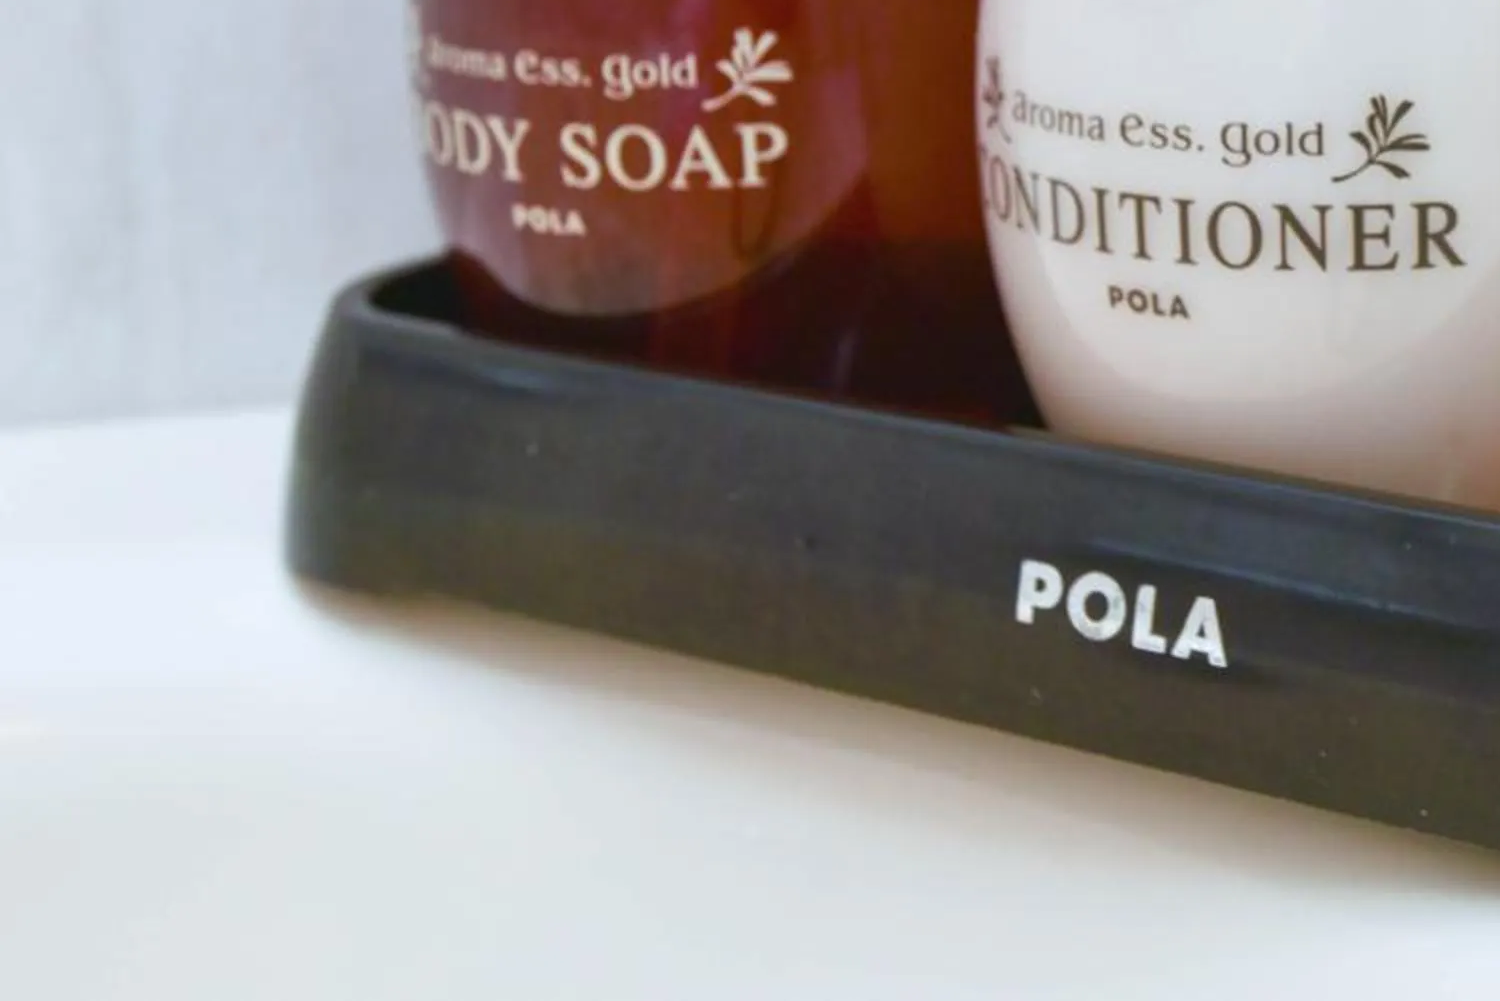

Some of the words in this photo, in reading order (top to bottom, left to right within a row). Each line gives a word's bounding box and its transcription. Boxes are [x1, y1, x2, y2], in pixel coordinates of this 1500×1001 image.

[600, 52, 699, 100] gold
[411, 94, 529, 181] ODY
[559, 121, 788, 191] SOAP
[1011, 89, 1106, 141] aroma
[1119, 113, 1205, 152] ess.
[1219, 122, 1324, 167] gold
[511, 204, 586, 236] POLA
[1108, 285, 1190, 320] POLA
[1015, 558, 1228, 668] POLA
